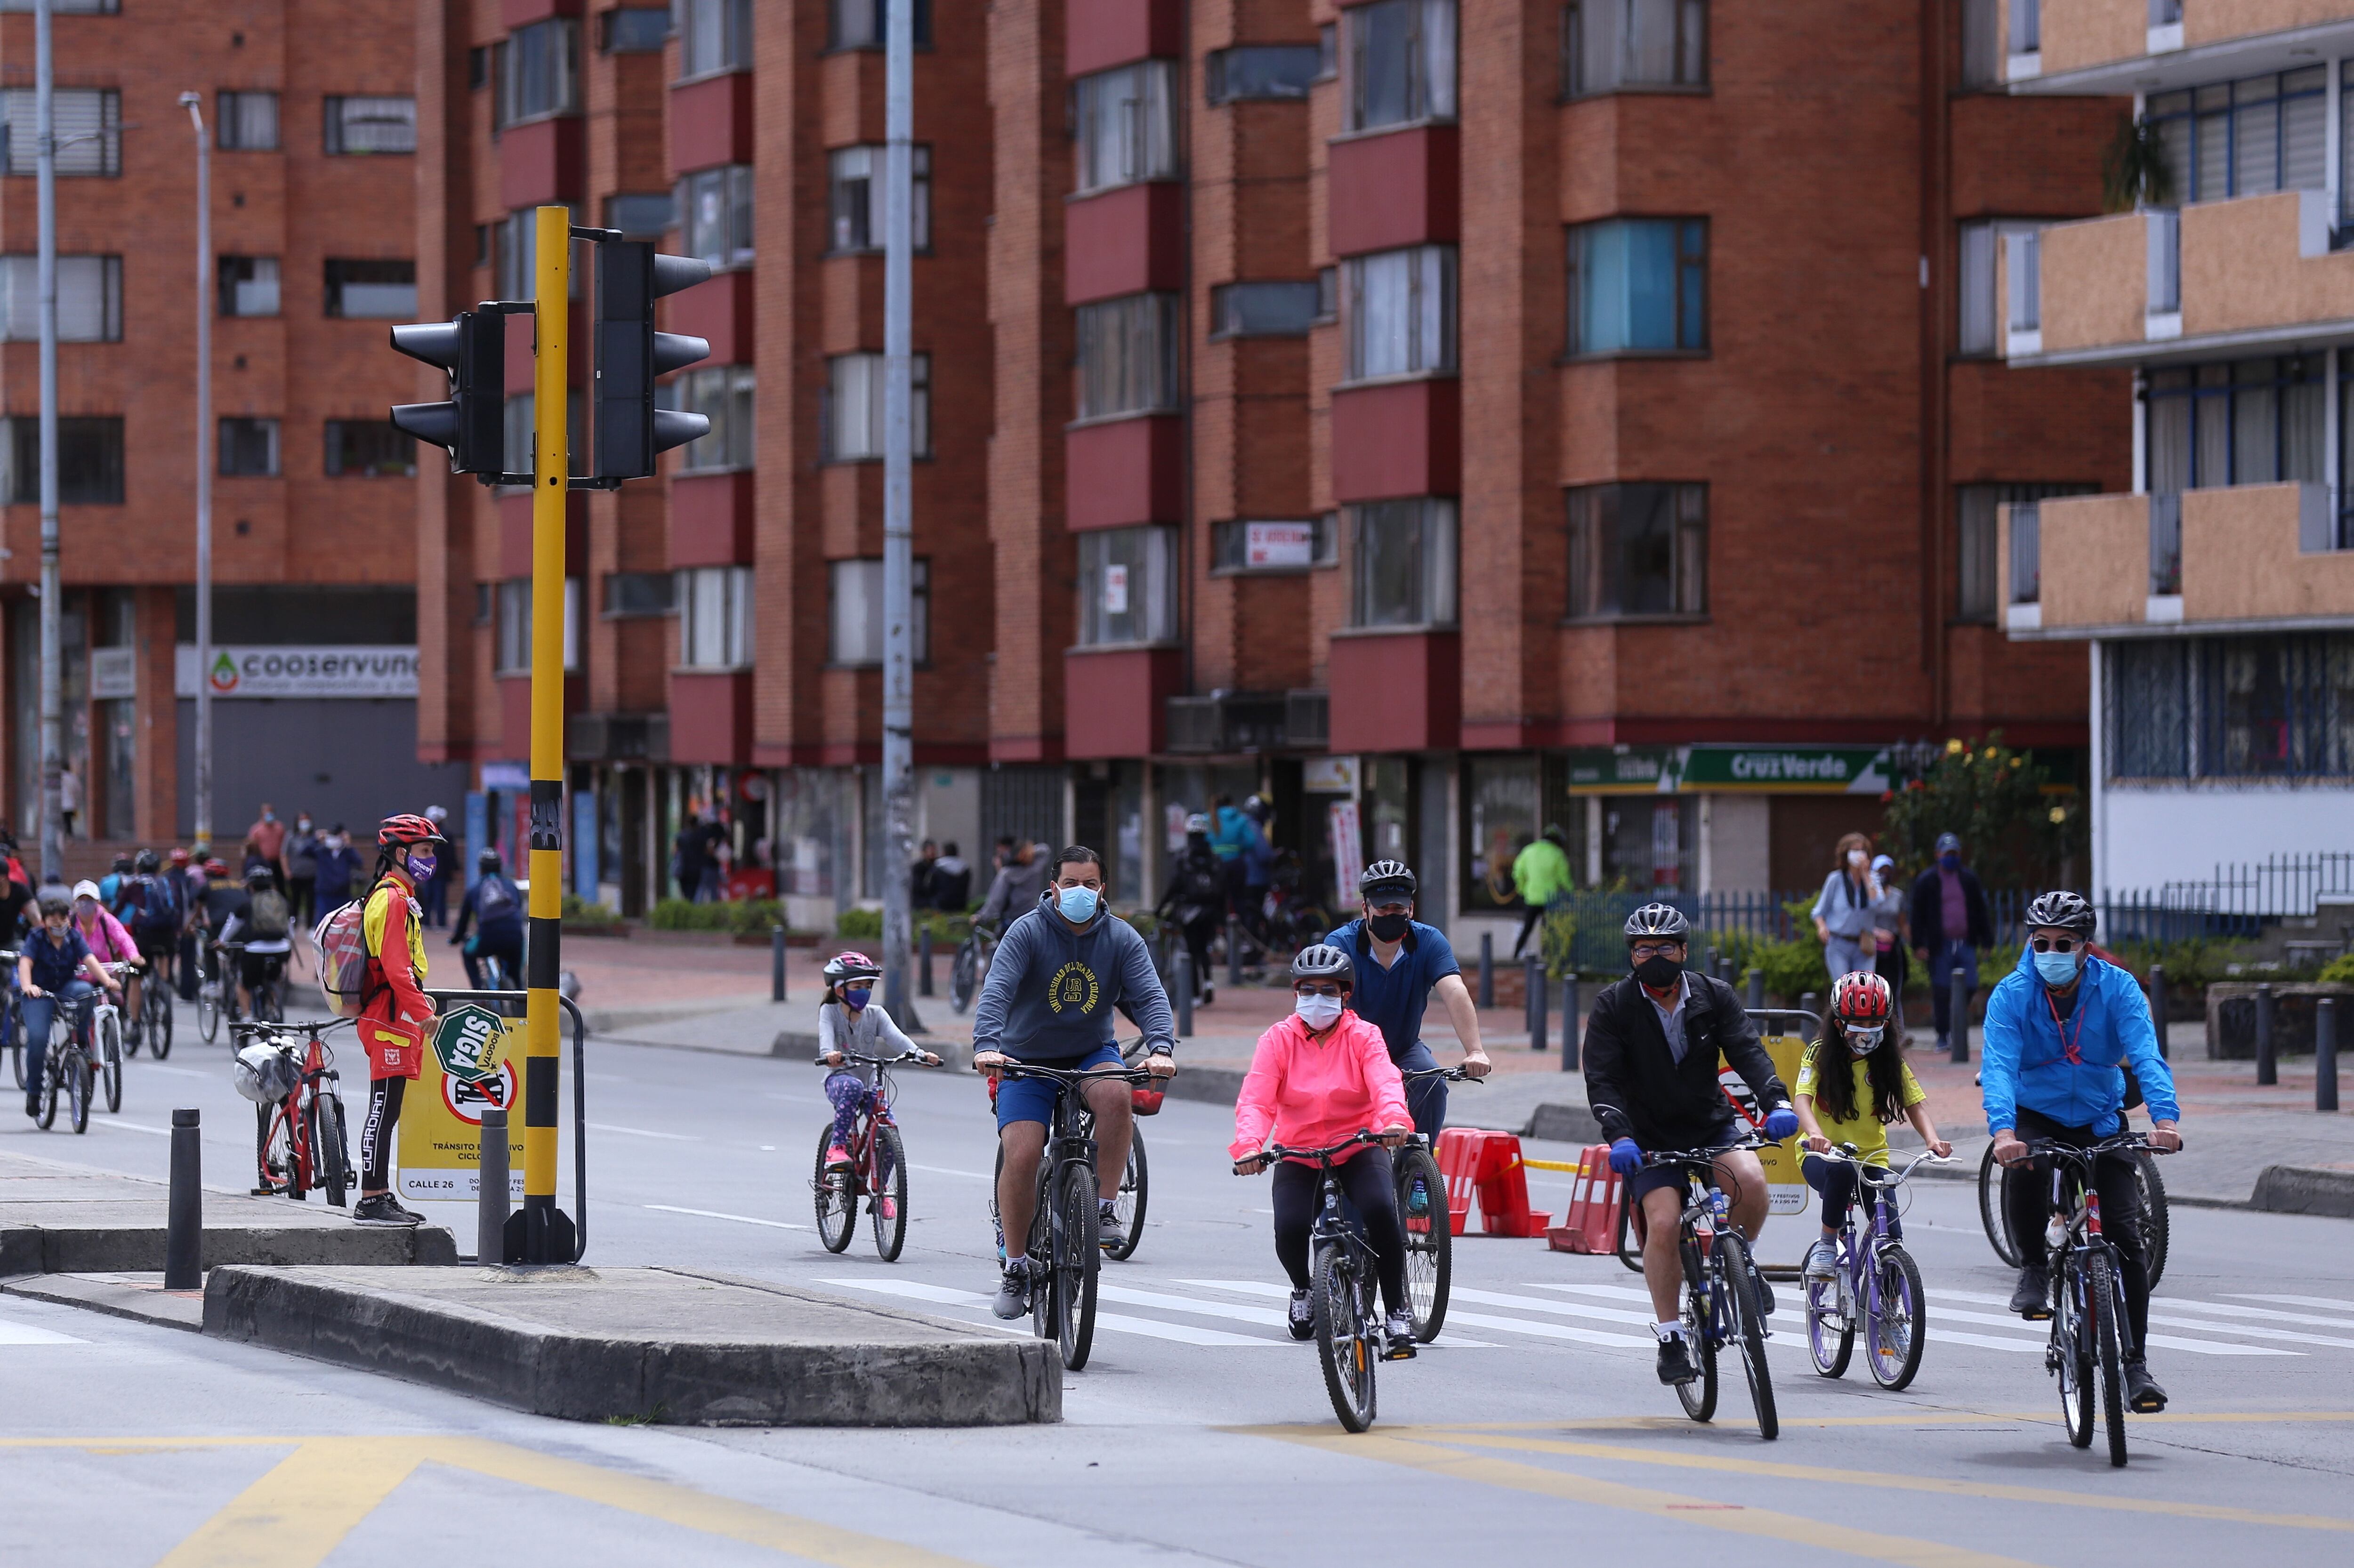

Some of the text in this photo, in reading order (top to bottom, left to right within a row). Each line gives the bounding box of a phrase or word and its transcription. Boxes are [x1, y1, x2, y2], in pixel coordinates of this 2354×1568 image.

[1048, 968, 1065, 1013] UNIVERSIDAD
[1080, 982, 1099, 1014] COLOMBIA
[449, 1015, 491, 1069] SIGA
[363, 1092, 384, 1172] GUARDIAN
[433, 1142, 475, 1150] TRÁNSITO
